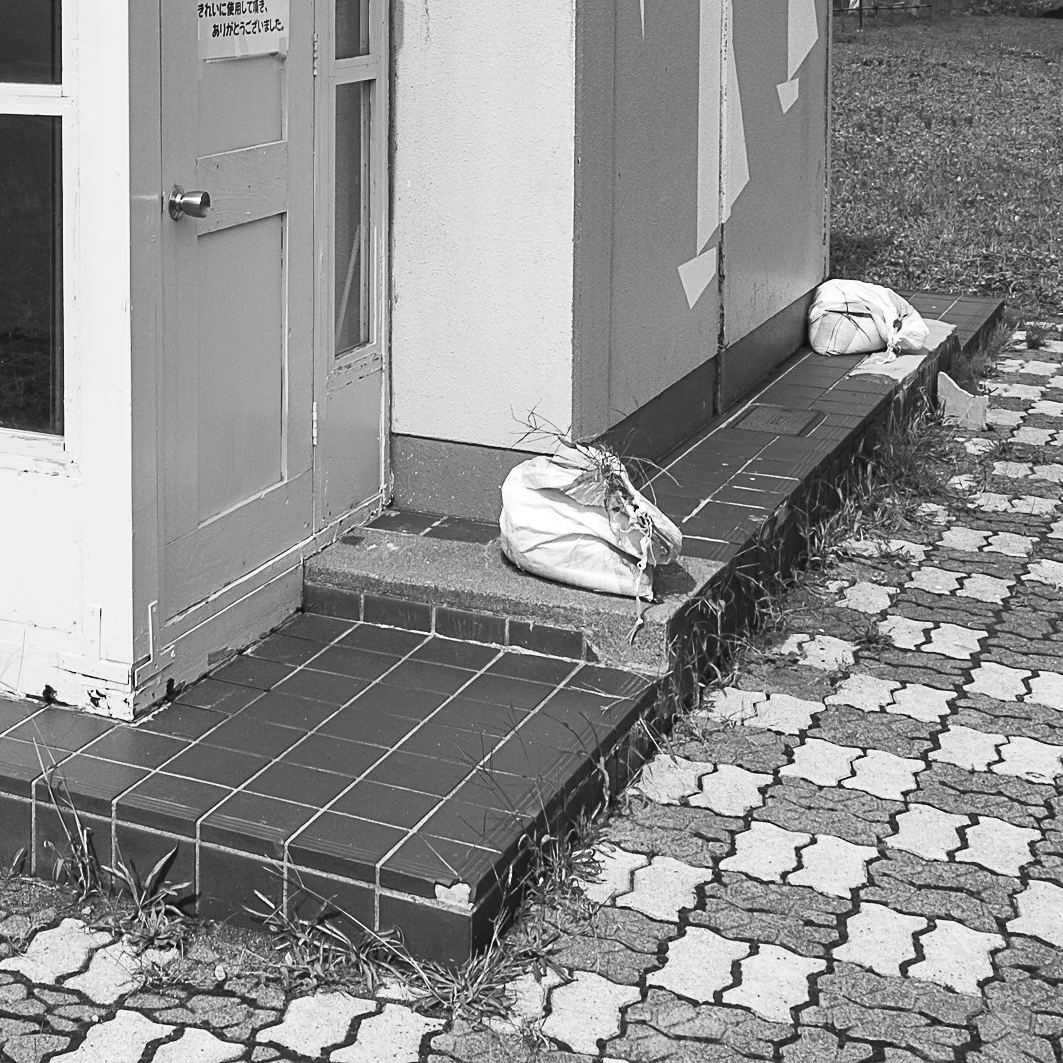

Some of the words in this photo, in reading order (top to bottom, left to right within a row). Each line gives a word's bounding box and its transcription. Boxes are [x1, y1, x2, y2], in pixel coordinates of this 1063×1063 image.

[197, 0, 268, 18] きれいに使用して頂き、
[212, 18, 284, 38] ありがとうございました。
